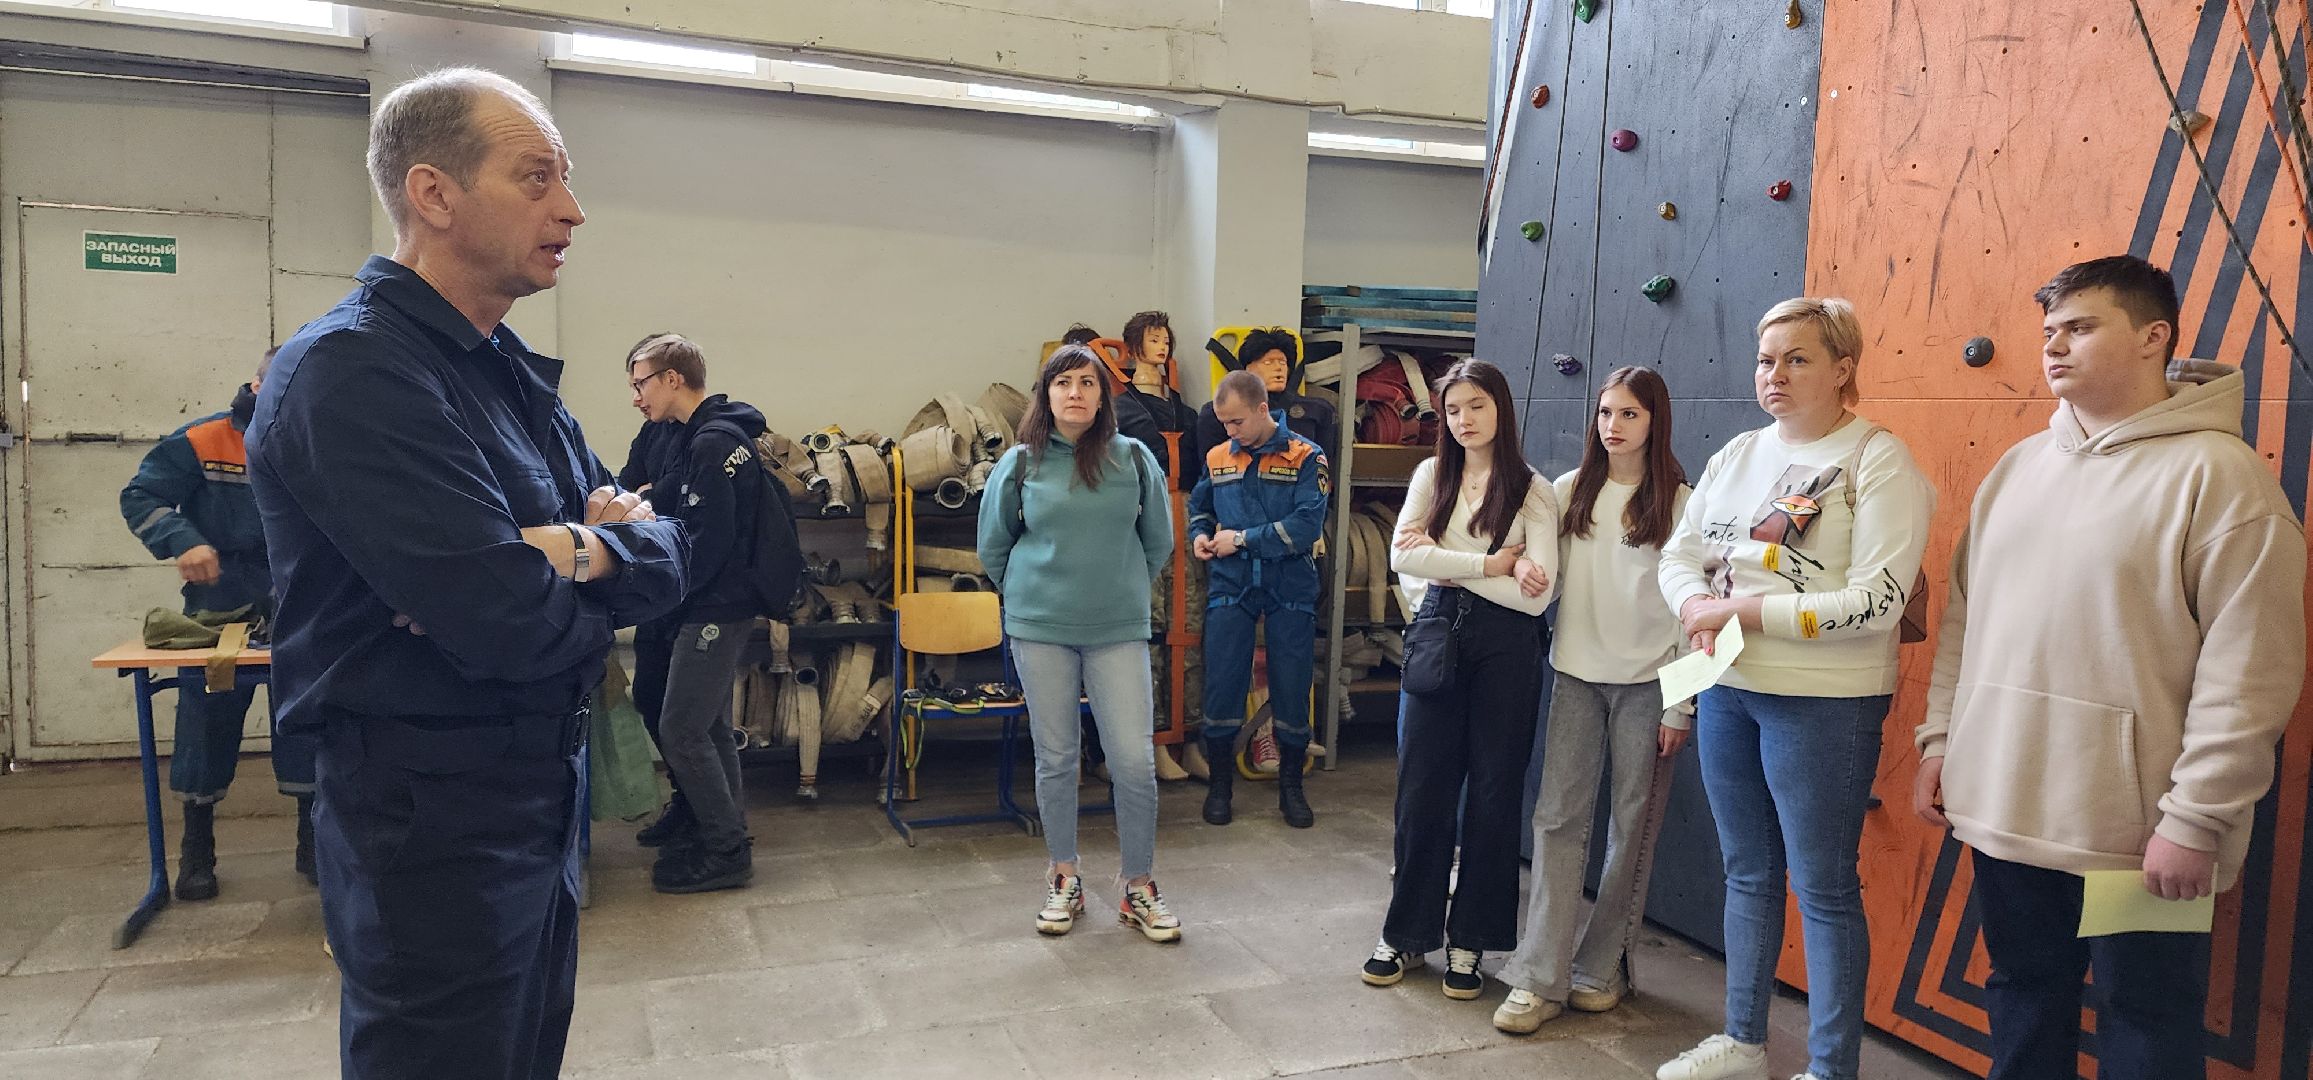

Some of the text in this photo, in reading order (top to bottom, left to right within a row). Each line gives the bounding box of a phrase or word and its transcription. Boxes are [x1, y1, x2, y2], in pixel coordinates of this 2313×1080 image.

[86, 240, 176, 255] ЗАПАСНЫЙ
[101, 253, 162, 268] ВЫХОД
[1818, 567, 1905, 631] Inspire
